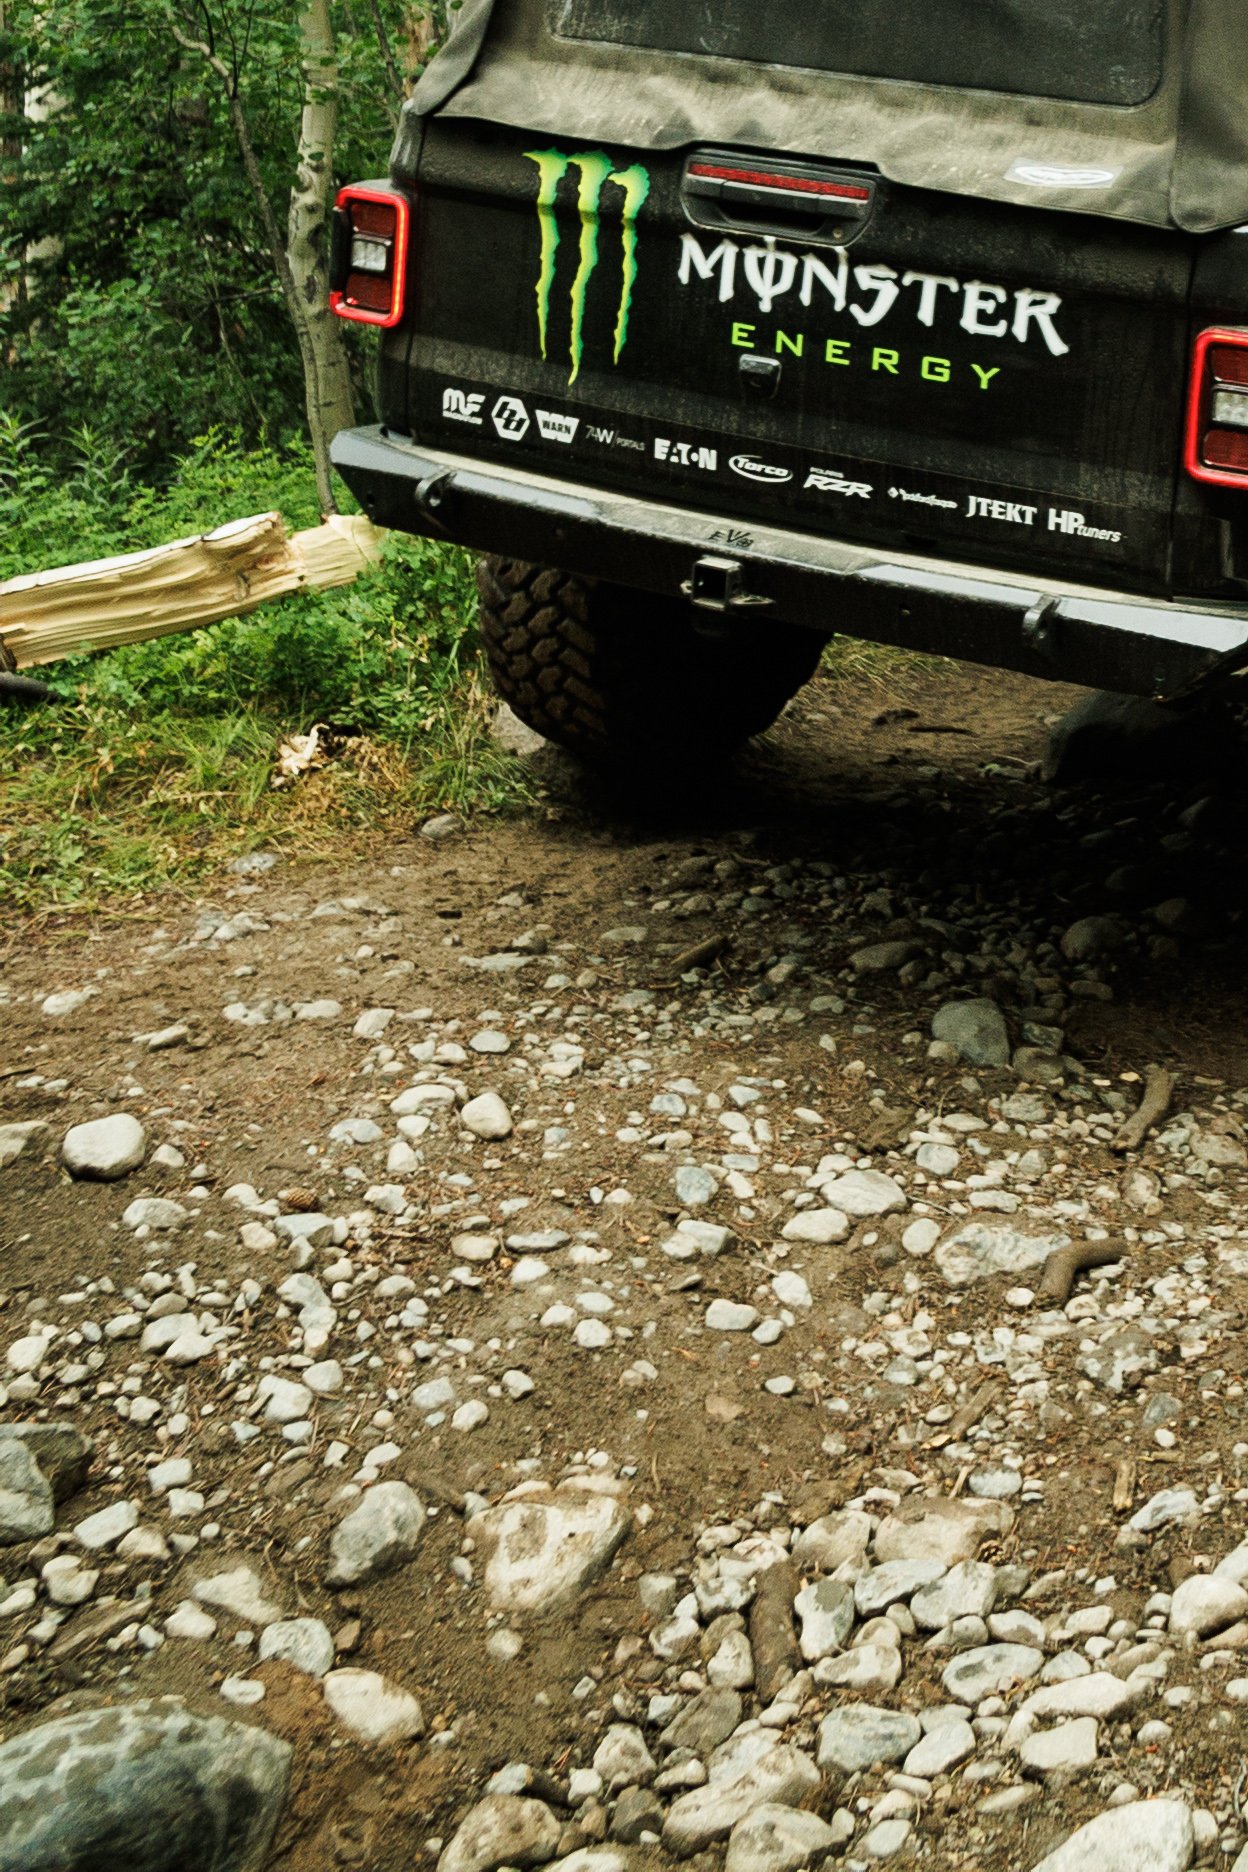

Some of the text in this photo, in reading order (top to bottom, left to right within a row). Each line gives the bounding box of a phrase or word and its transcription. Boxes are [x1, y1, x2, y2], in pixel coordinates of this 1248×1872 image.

[678, 232, 1070, 357] MONSTER
[731, 322, 1000, 390] ENERGY
[541, 419, 572, 436] WARN
[736, 457, 788, 477] Torco
[803, 473, 874, 499] RZR
[966, 495, 1038, 525] JTEKT
